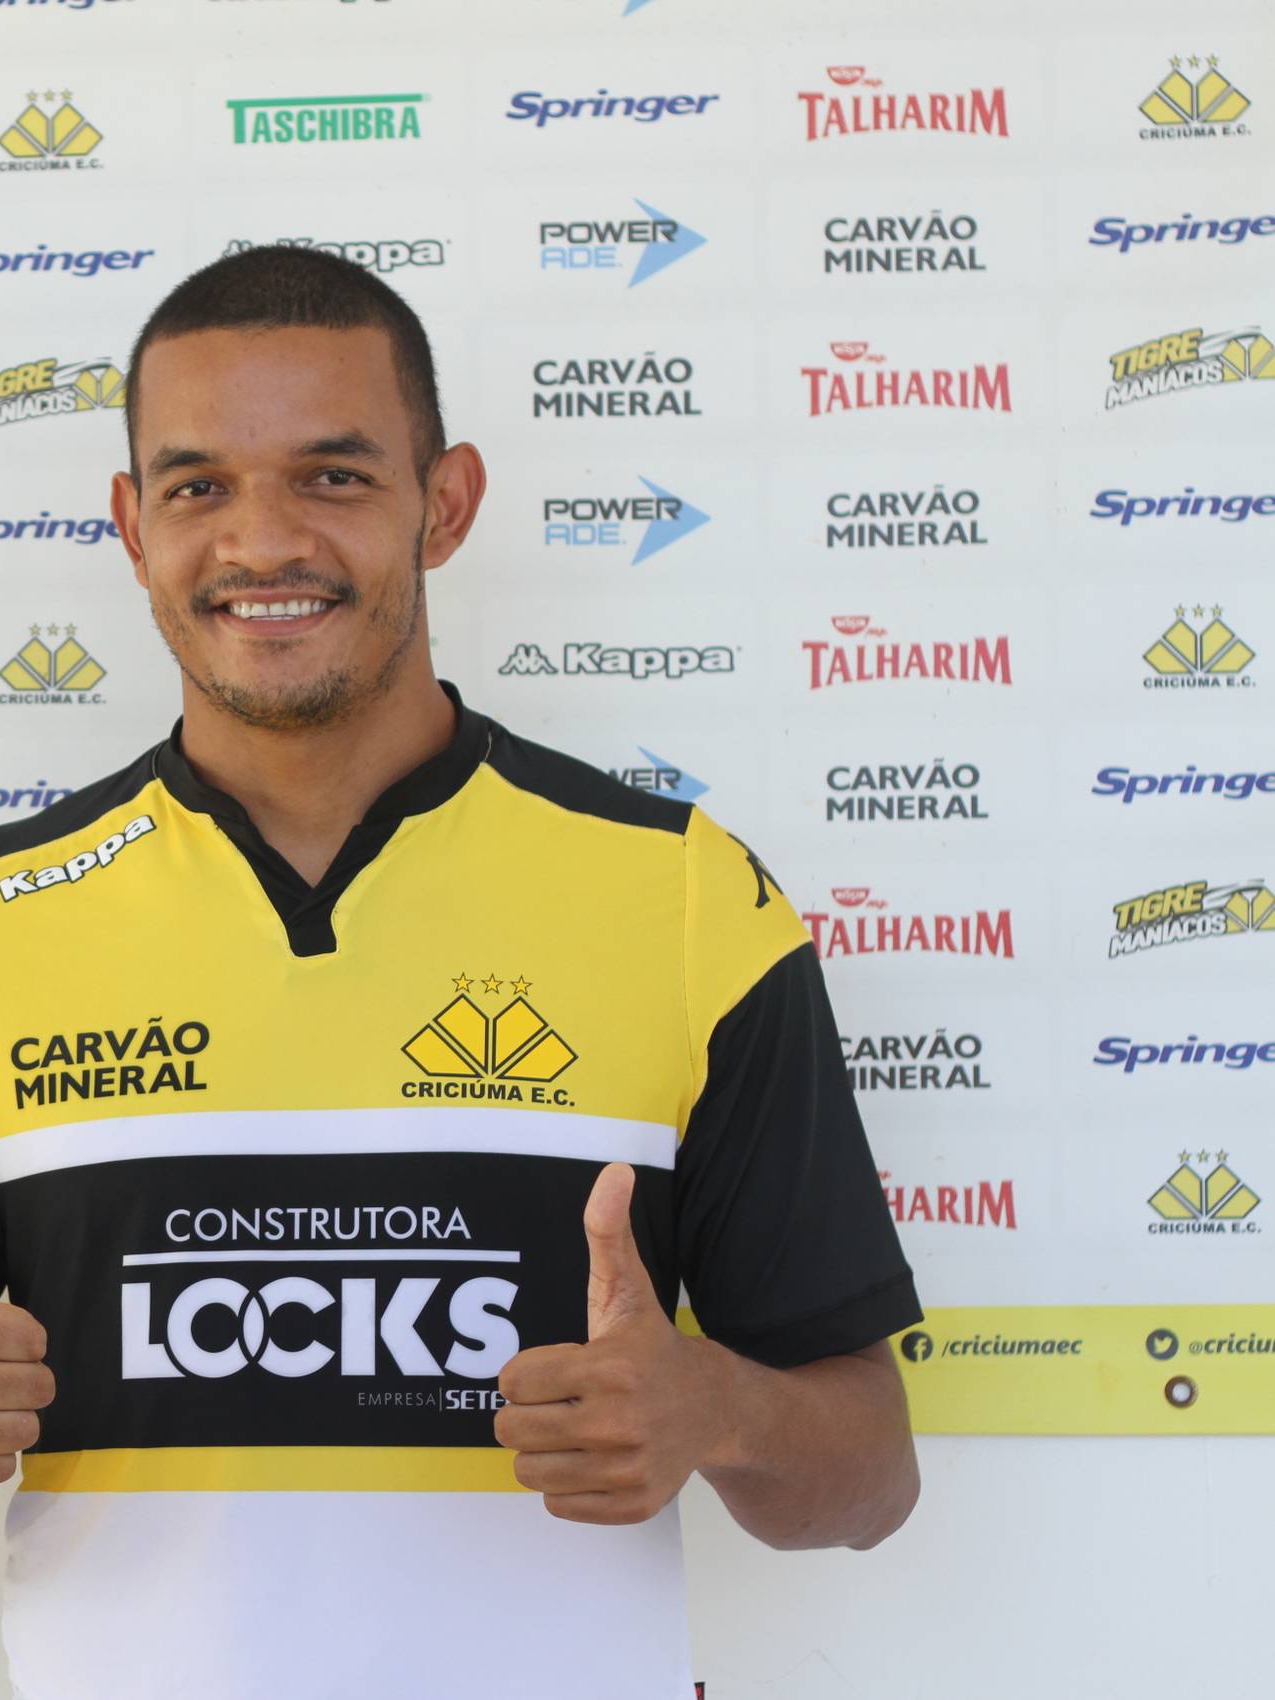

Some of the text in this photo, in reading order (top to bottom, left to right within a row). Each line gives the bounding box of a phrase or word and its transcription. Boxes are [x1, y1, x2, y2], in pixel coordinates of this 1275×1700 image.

[226, 93, 429, 145] TASCHIBRA
[505, 89, 720, 128] Springer
[798, 87, 1009, 141] TALHARIM
[1221, 123, 1252, 137] E.C.
[74, 157, 104, 170] E.C.
[540, 219, 679, 245] POWER
[824, 210, 978, 244] CARVÃO
[1089, 213, 1275, 253] Springe
[278, 237, 446, 272] ppa
[824, 247, 986, 273] MINERAL
[533, 350, 693, 386] CARVÃO
[1110, 327, 1204, 381] TIGRE
[533, 390, 702, 418] MINERAL
[801, 363, 1012, 416] TALHARIM
[544, 497, 682, 521] POWER
[826, 485, 980, 518] CARVÃO
[1090, 487, 1275, 526] Springe
[826, 521, 988, 548] MINERAL
[563, 642, 735, 679] Kappa
[802, 636, 1013, 690] TALHARIM
[77, 692, 107, 705] E.C.
[1225, 675, 1256, 689] E.C.
[827, 758, 980, 791] CARVÃO
[1091, 765, 1275, 804] Springe
[826, 794, 989, 821] MINERAL
[1112, 880, 1207, 932] TIGRE
[802, 910, 1015, 959] TALHARIM
[9, 1016, 212, 1071] CARVÃO
[1093, 1035, 1275, 1073] Springe
[14, 1060, 208, 1110] MINERAL
[401, 1077, 576, 1107] CRICIÚMA E.C.
[883, 1180, 1017, 1229] HARIM
[165, 1206, 472, 1243] CONSTRUTORA
[1230, 1221, 1262, 1234] E.C.
[121, 1277, 520, 1380] LOCKS
[941, 1334, 1083, 1358] /criciumaec
[1188, 1331, 1275, 1356] @criciu
[358, 1389, 510, 1410] EMPRESA SETE
